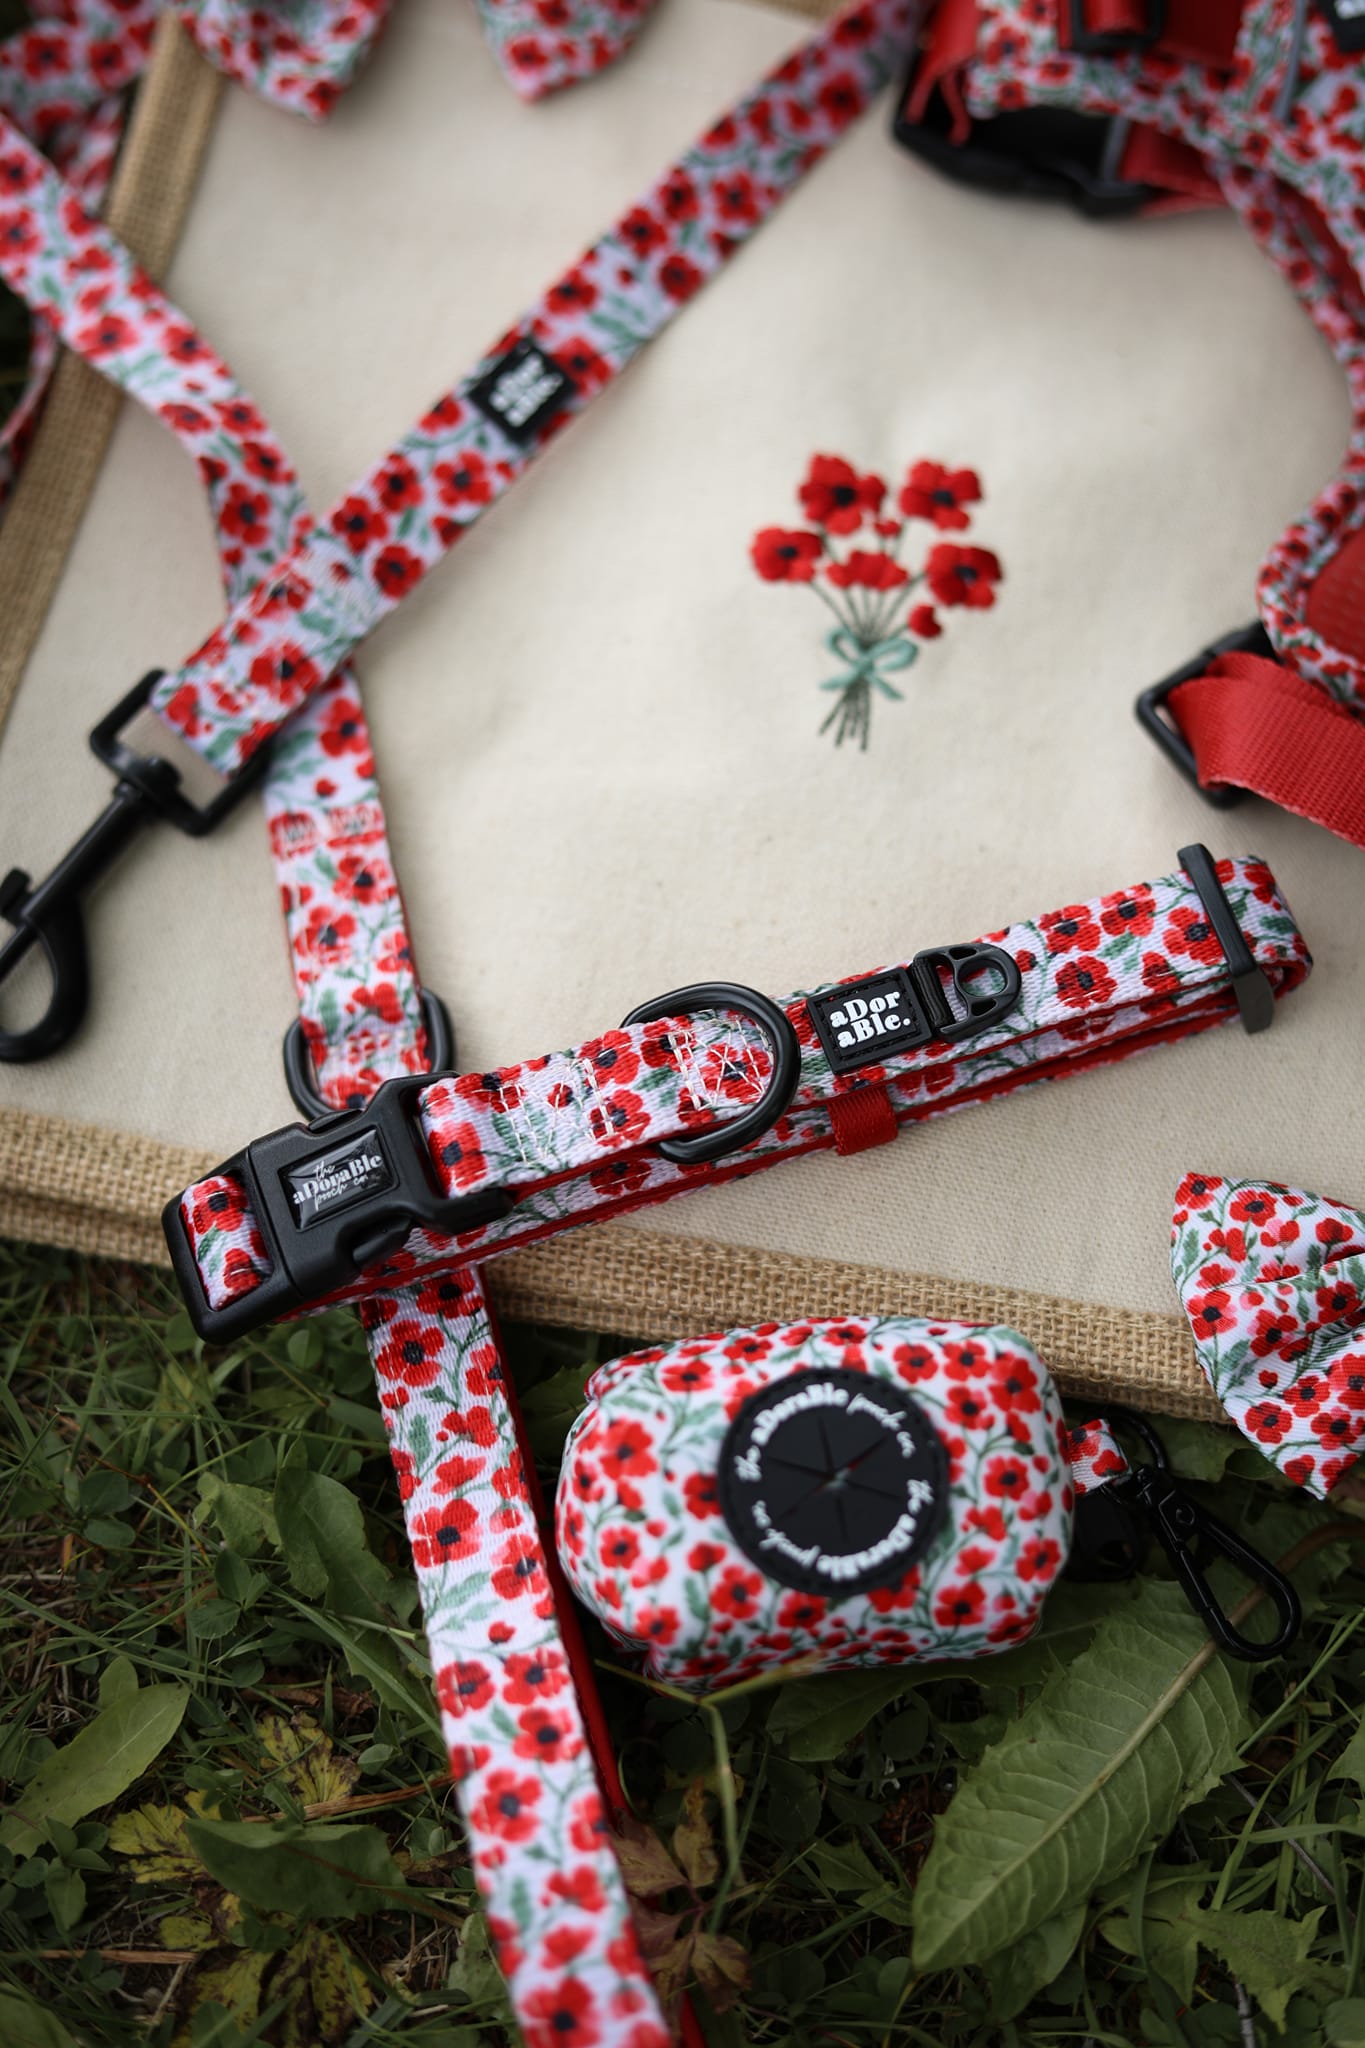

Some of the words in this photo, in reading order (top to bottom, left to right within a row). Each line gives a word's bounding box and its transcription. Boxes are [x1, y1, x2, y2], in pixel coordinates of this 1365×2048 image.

[830, 991, 900, 1028] aDor
[837, 1012, 911, 1048] aBle.
[292, 1154, 382, 1205] aDoraBle
[313, 1160, 336, 1181] the
